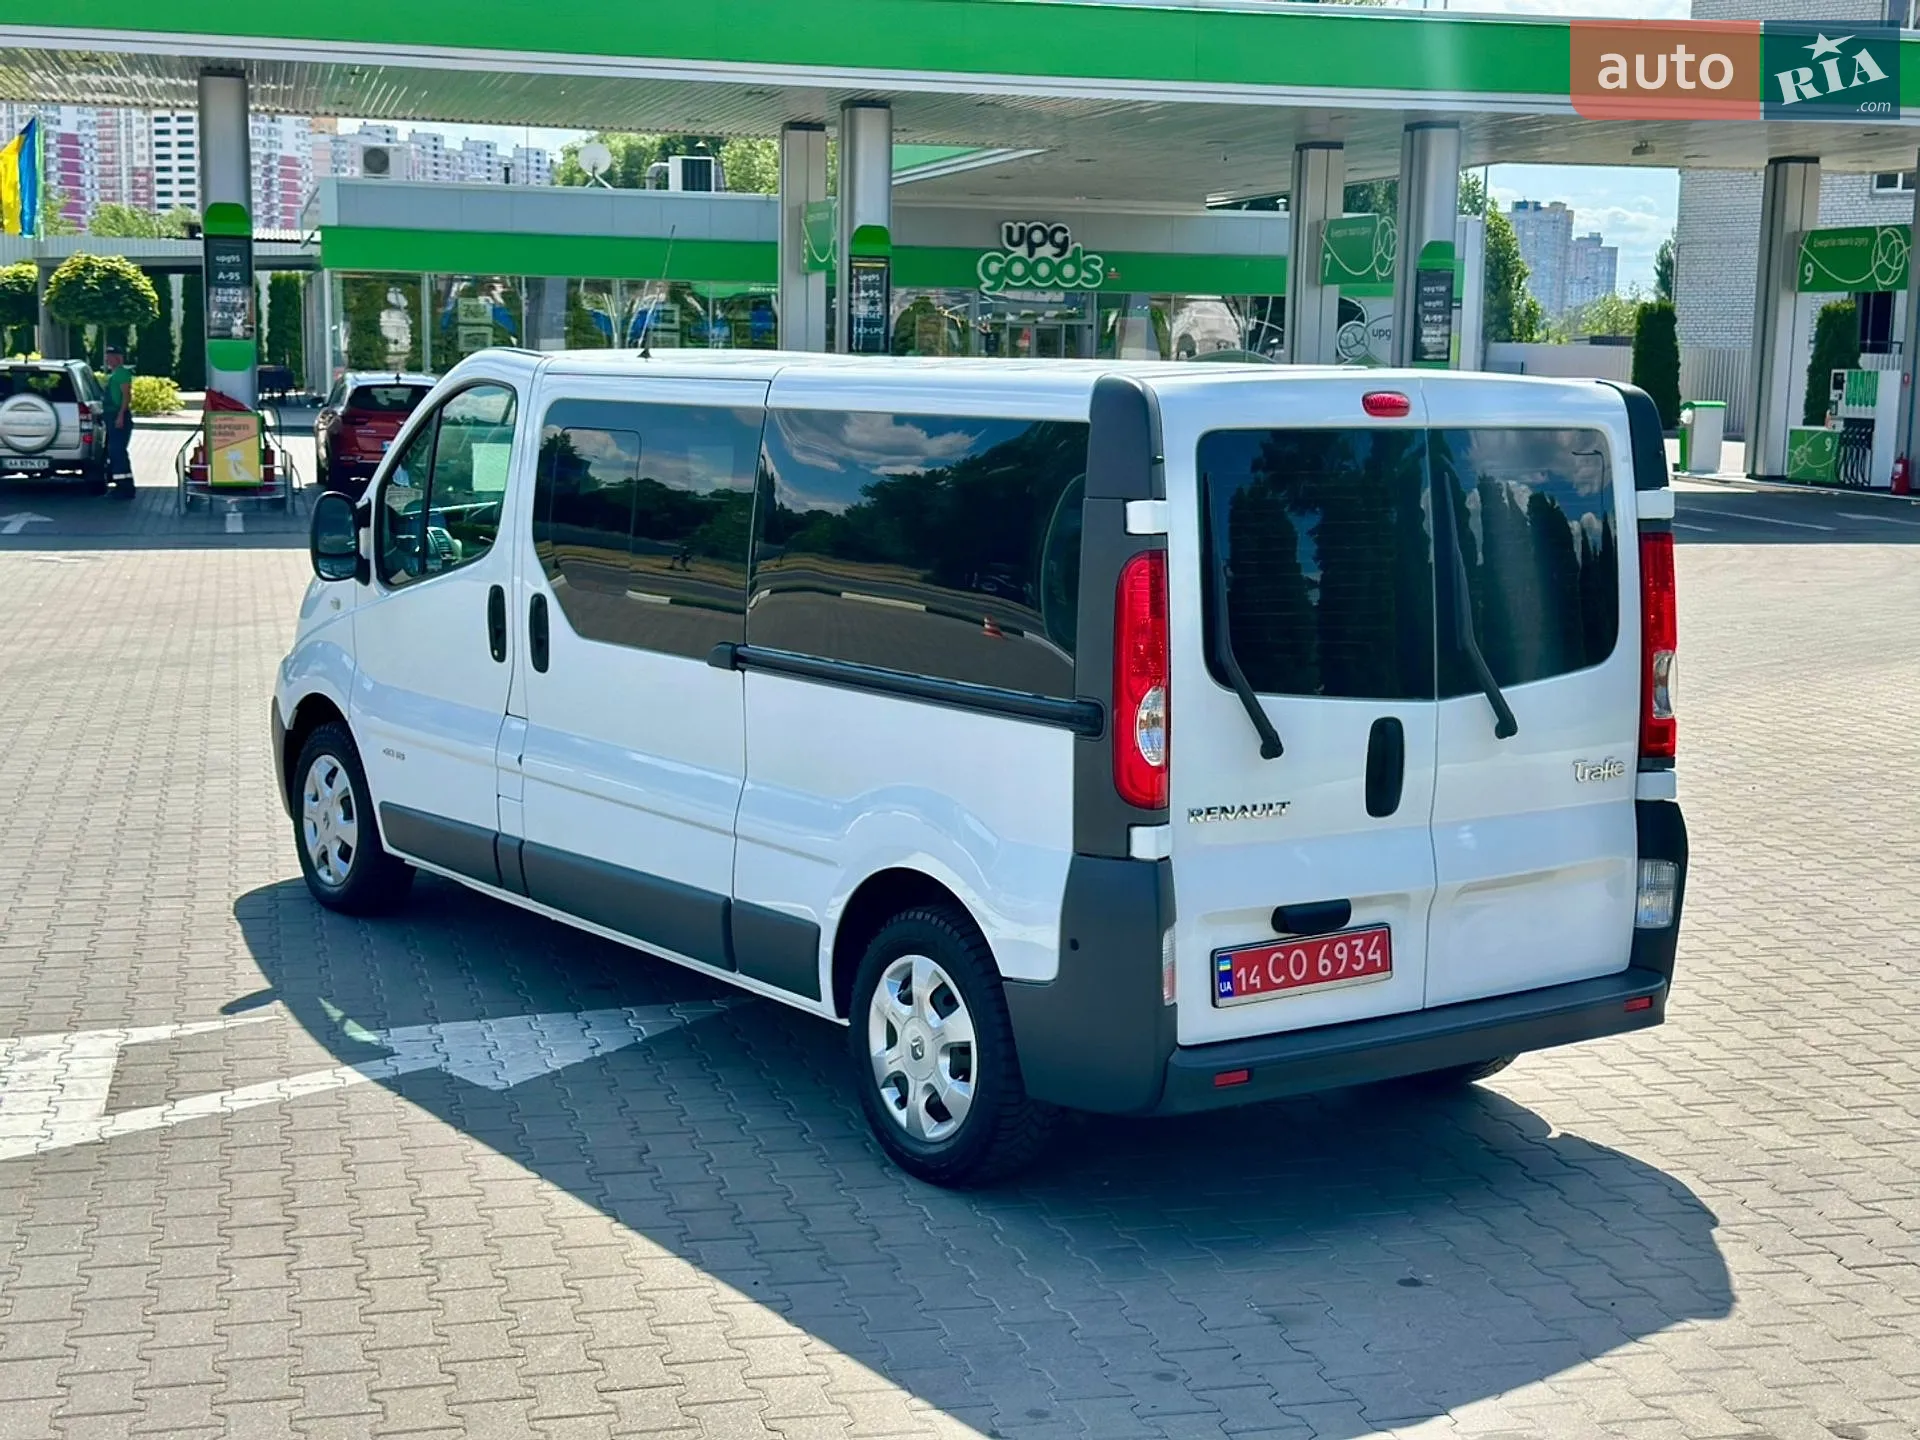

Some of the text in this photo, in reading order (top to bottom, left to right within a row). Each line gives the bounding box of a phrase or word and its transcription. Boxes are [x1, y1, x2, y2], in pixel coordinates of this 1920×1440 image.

[1002, 222, 1070, 259] upg
[977, 243, 1103, 295] goods
[1804, 262, 1814, 285] 9
[1371, 328, 1392, 341] upg
[1187, 800, 1291, 825] RENAULT
[1236, 935, 1384, 991] 14 CO 6934
[1219, 981, 1233, 993] UA
